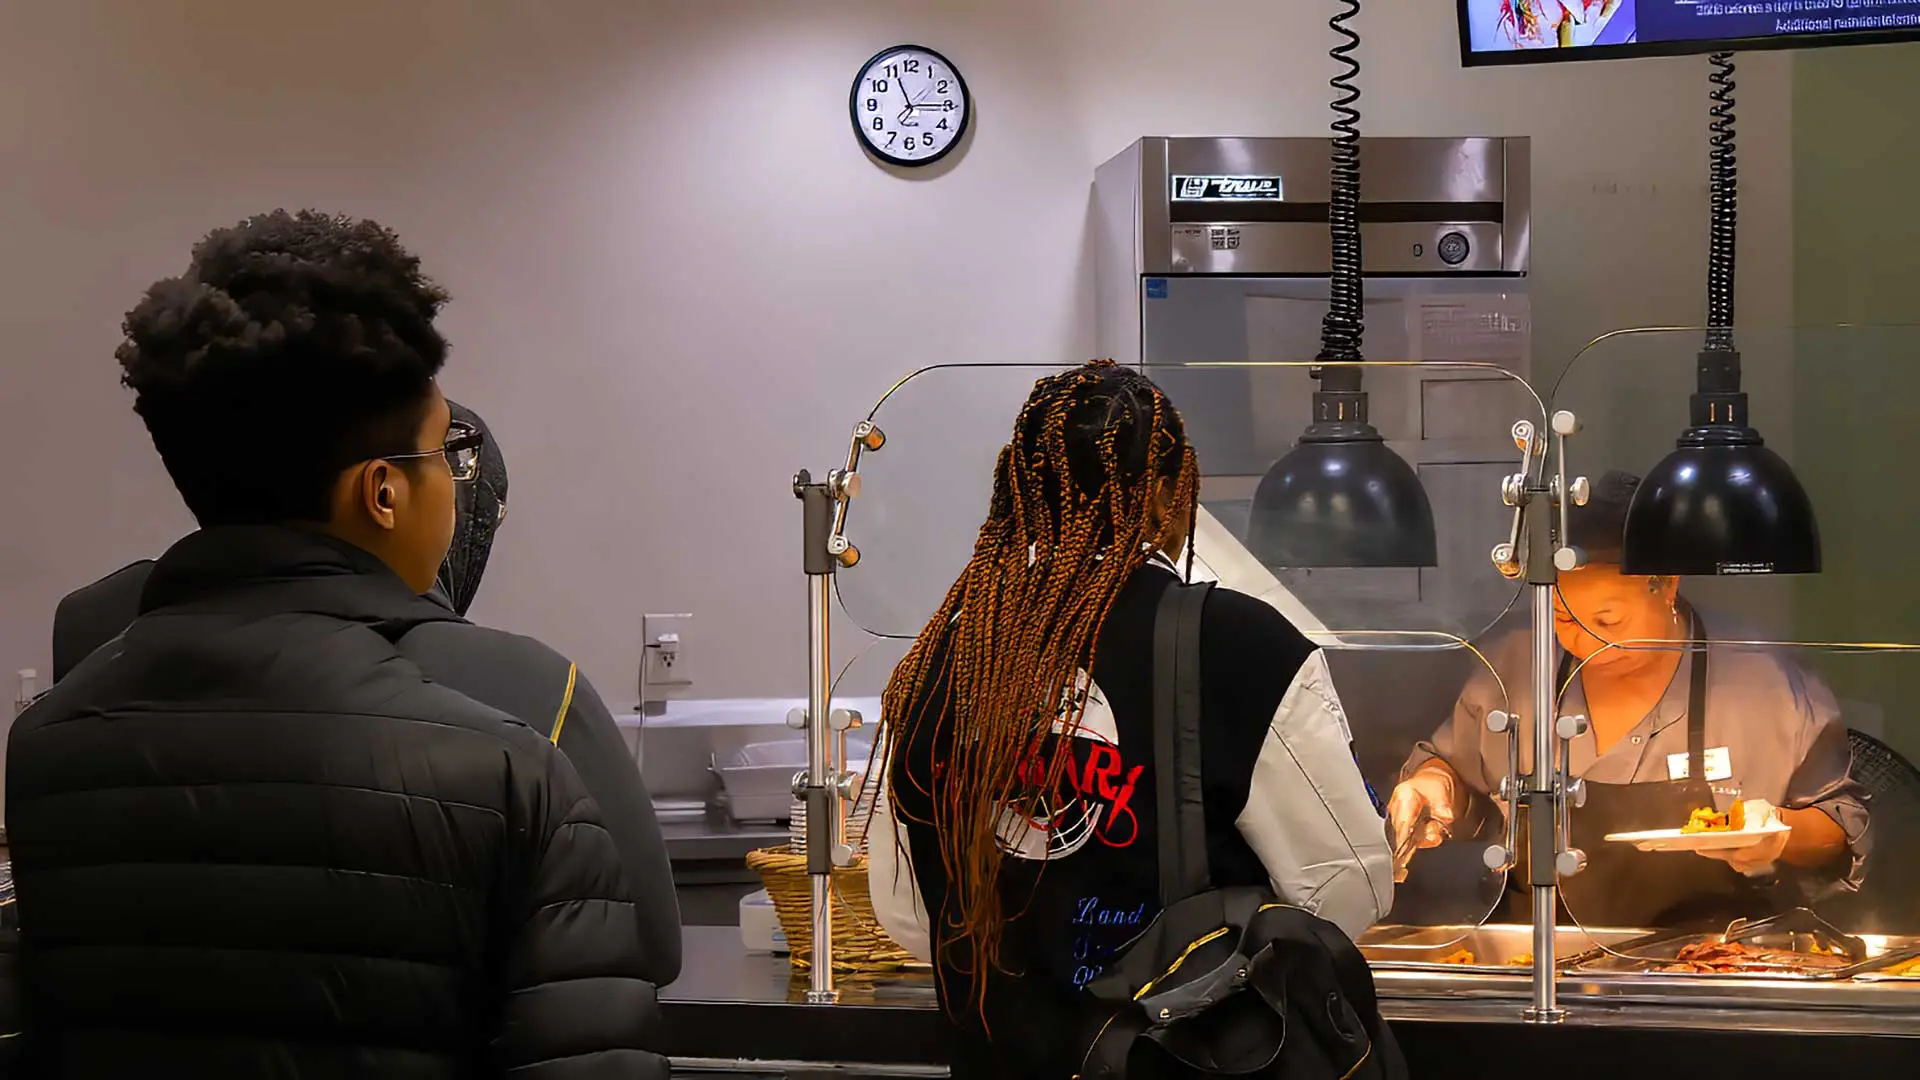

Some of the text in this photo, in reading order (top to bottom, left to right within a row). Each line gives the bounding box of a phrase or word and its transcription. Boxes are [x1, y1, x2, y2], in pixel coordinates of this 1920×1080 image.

[884, 64, 898, 78] 11
[904, 60, 919, 73] 12
[928, 65, 933, 79] 1
[872, 79, 888, 93] 10
[937, 80, 948, 94] 2
[867, 98, 877, 111] 9
[872, 117, 883, 131] 8
[935, 118, 948, 130] 4
[887, 131, 897, 145] 7
[904, 137, 916, 150] 6
[923, 132, 934, 146] 5
